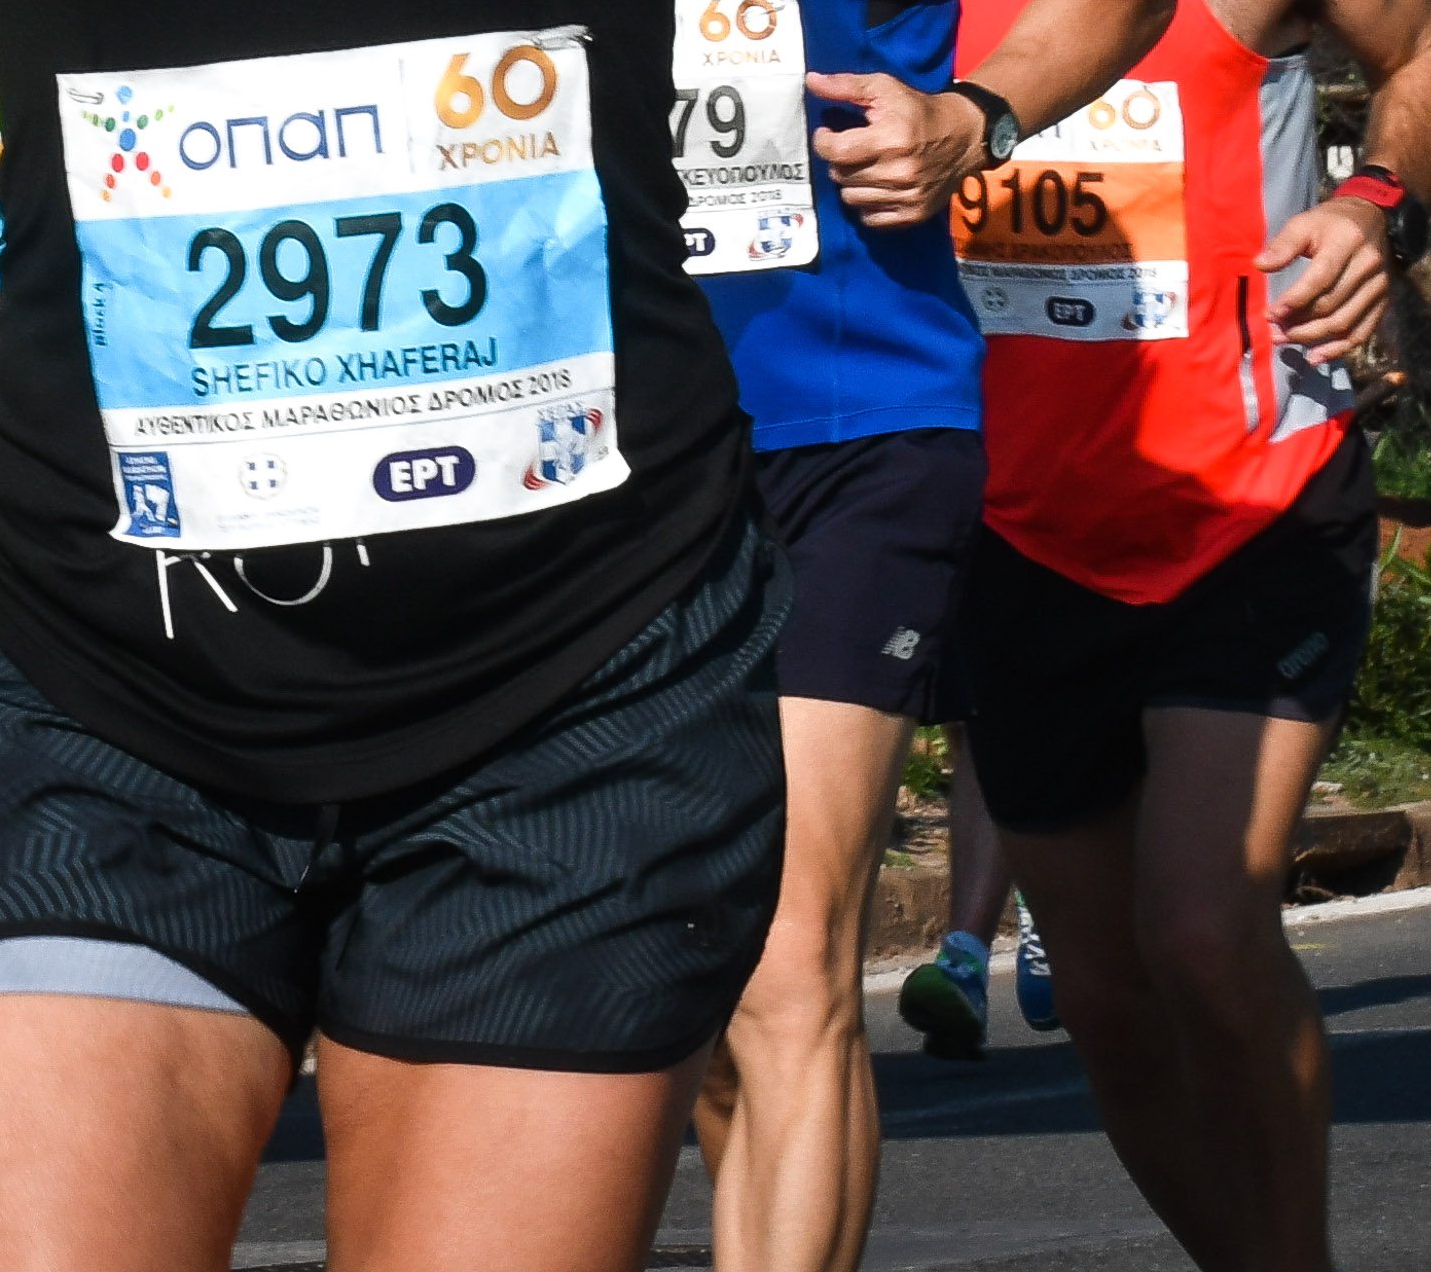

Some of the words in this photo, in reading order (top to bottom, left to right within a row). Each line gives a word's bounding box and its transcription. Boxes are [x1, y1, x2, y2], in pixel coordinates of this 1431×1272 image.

[435, 45, 557, 128] 60
[436, 131, 559, 171] ΧΡΟΝΙΑ
[959, 168, 1108, 238] 9105
[684, 233, 708, 252] ΡΤ
[187, 202, 488, 349] 2973
[191, 357, 327, 396] SHEFIKO
[336, 339, 498, 384] XHAFERAJ
